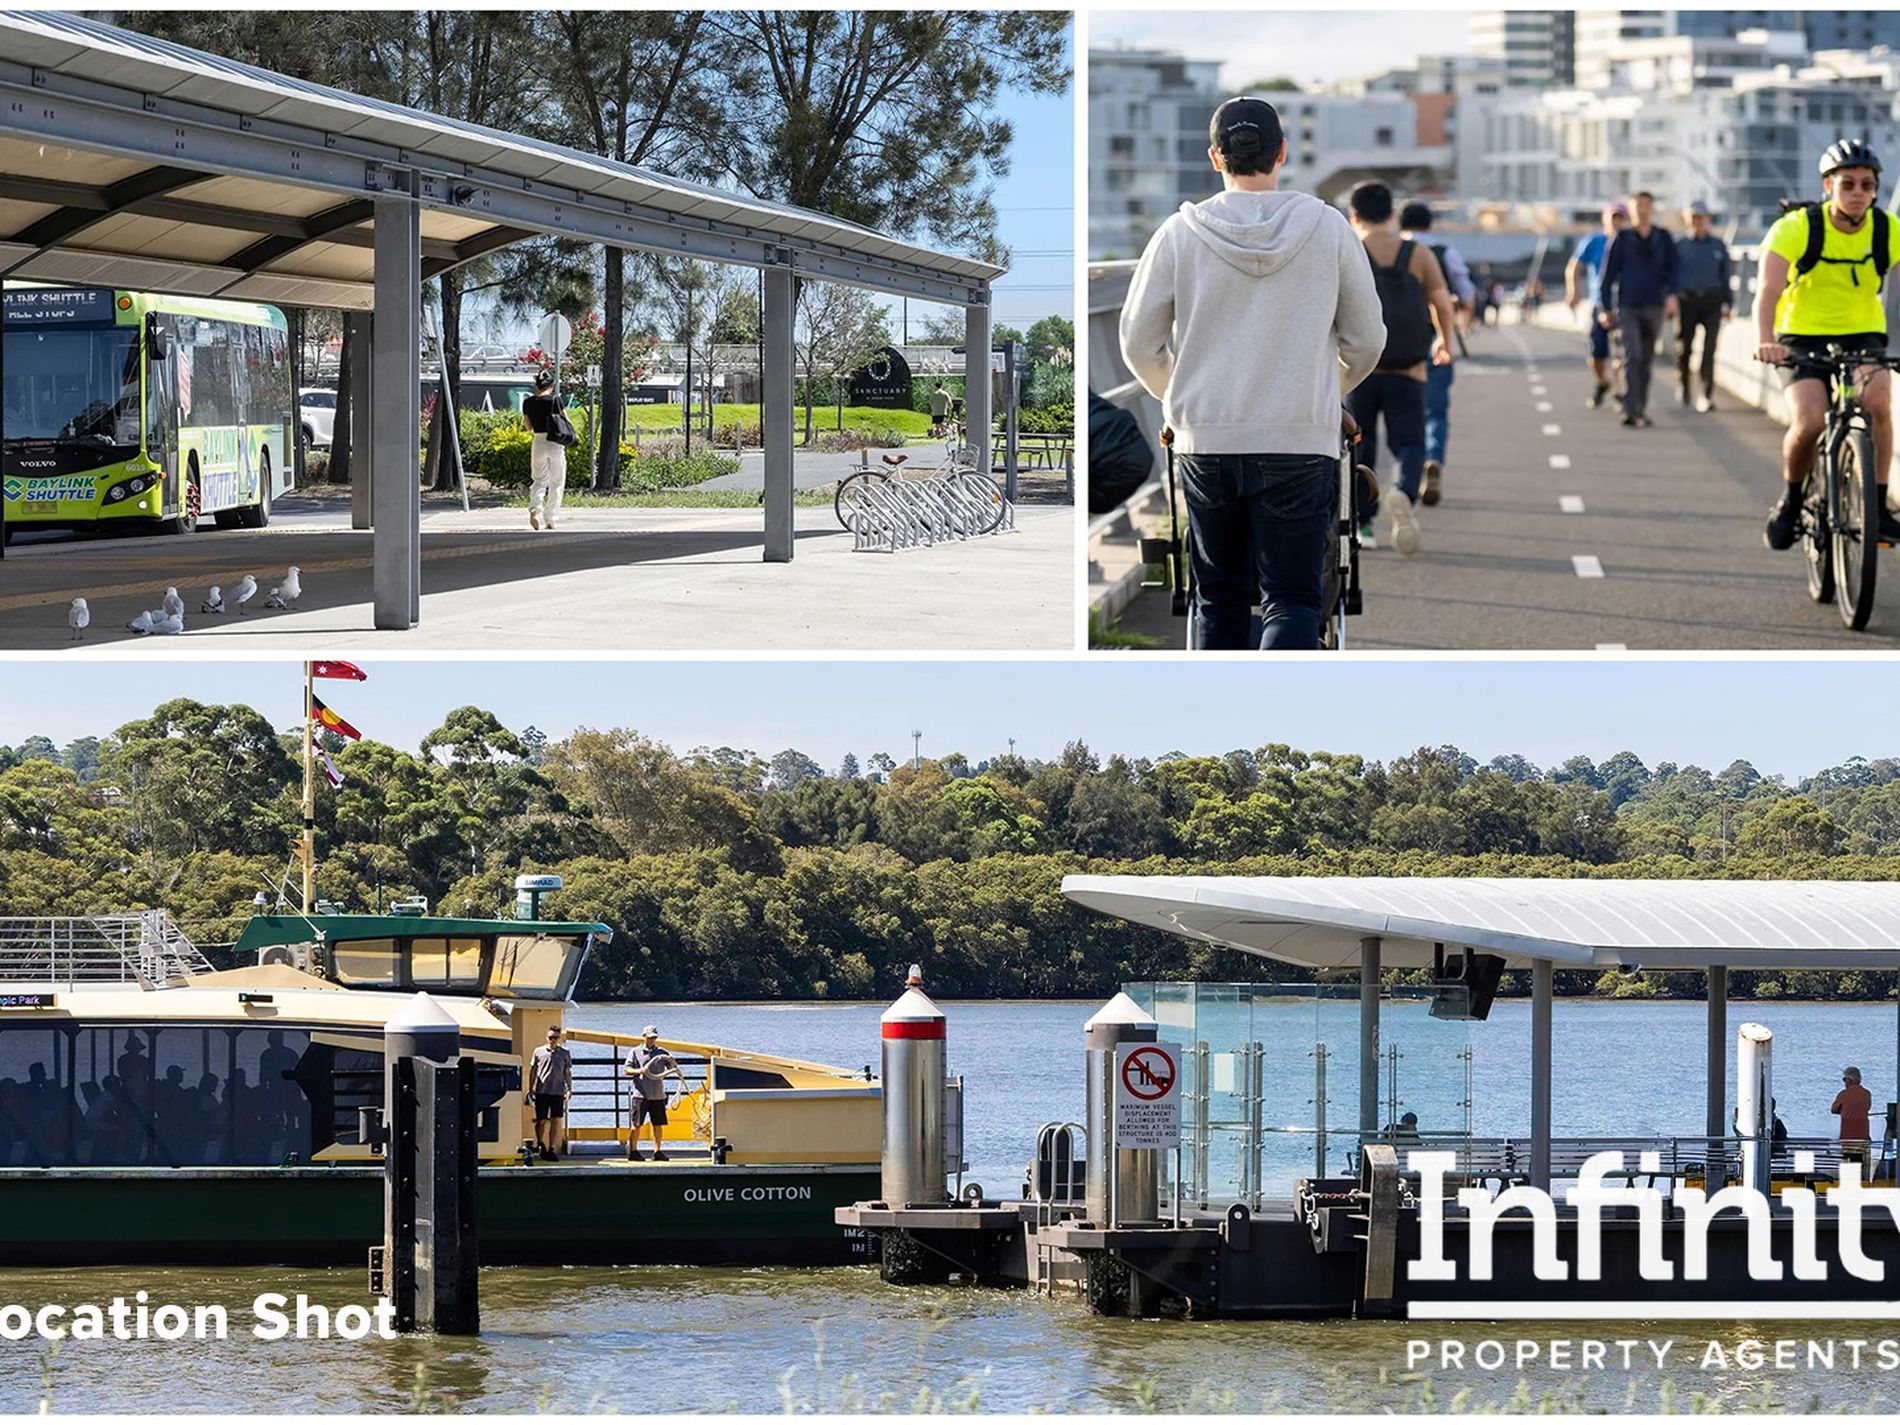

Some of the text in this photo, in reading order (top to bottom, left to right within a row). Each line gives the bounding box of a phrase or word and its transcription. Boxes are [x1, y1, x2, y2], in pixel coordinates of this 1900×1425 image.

[41, 292, 96, 305] SHUTTLE
[27, 477, 95, 489] BAYLINK
[26, 488, 95, 501] SHUTTLE
[19, 996, 40, 1005] Park
[683, 1186, 811, 1202] OLIVE COTTON
